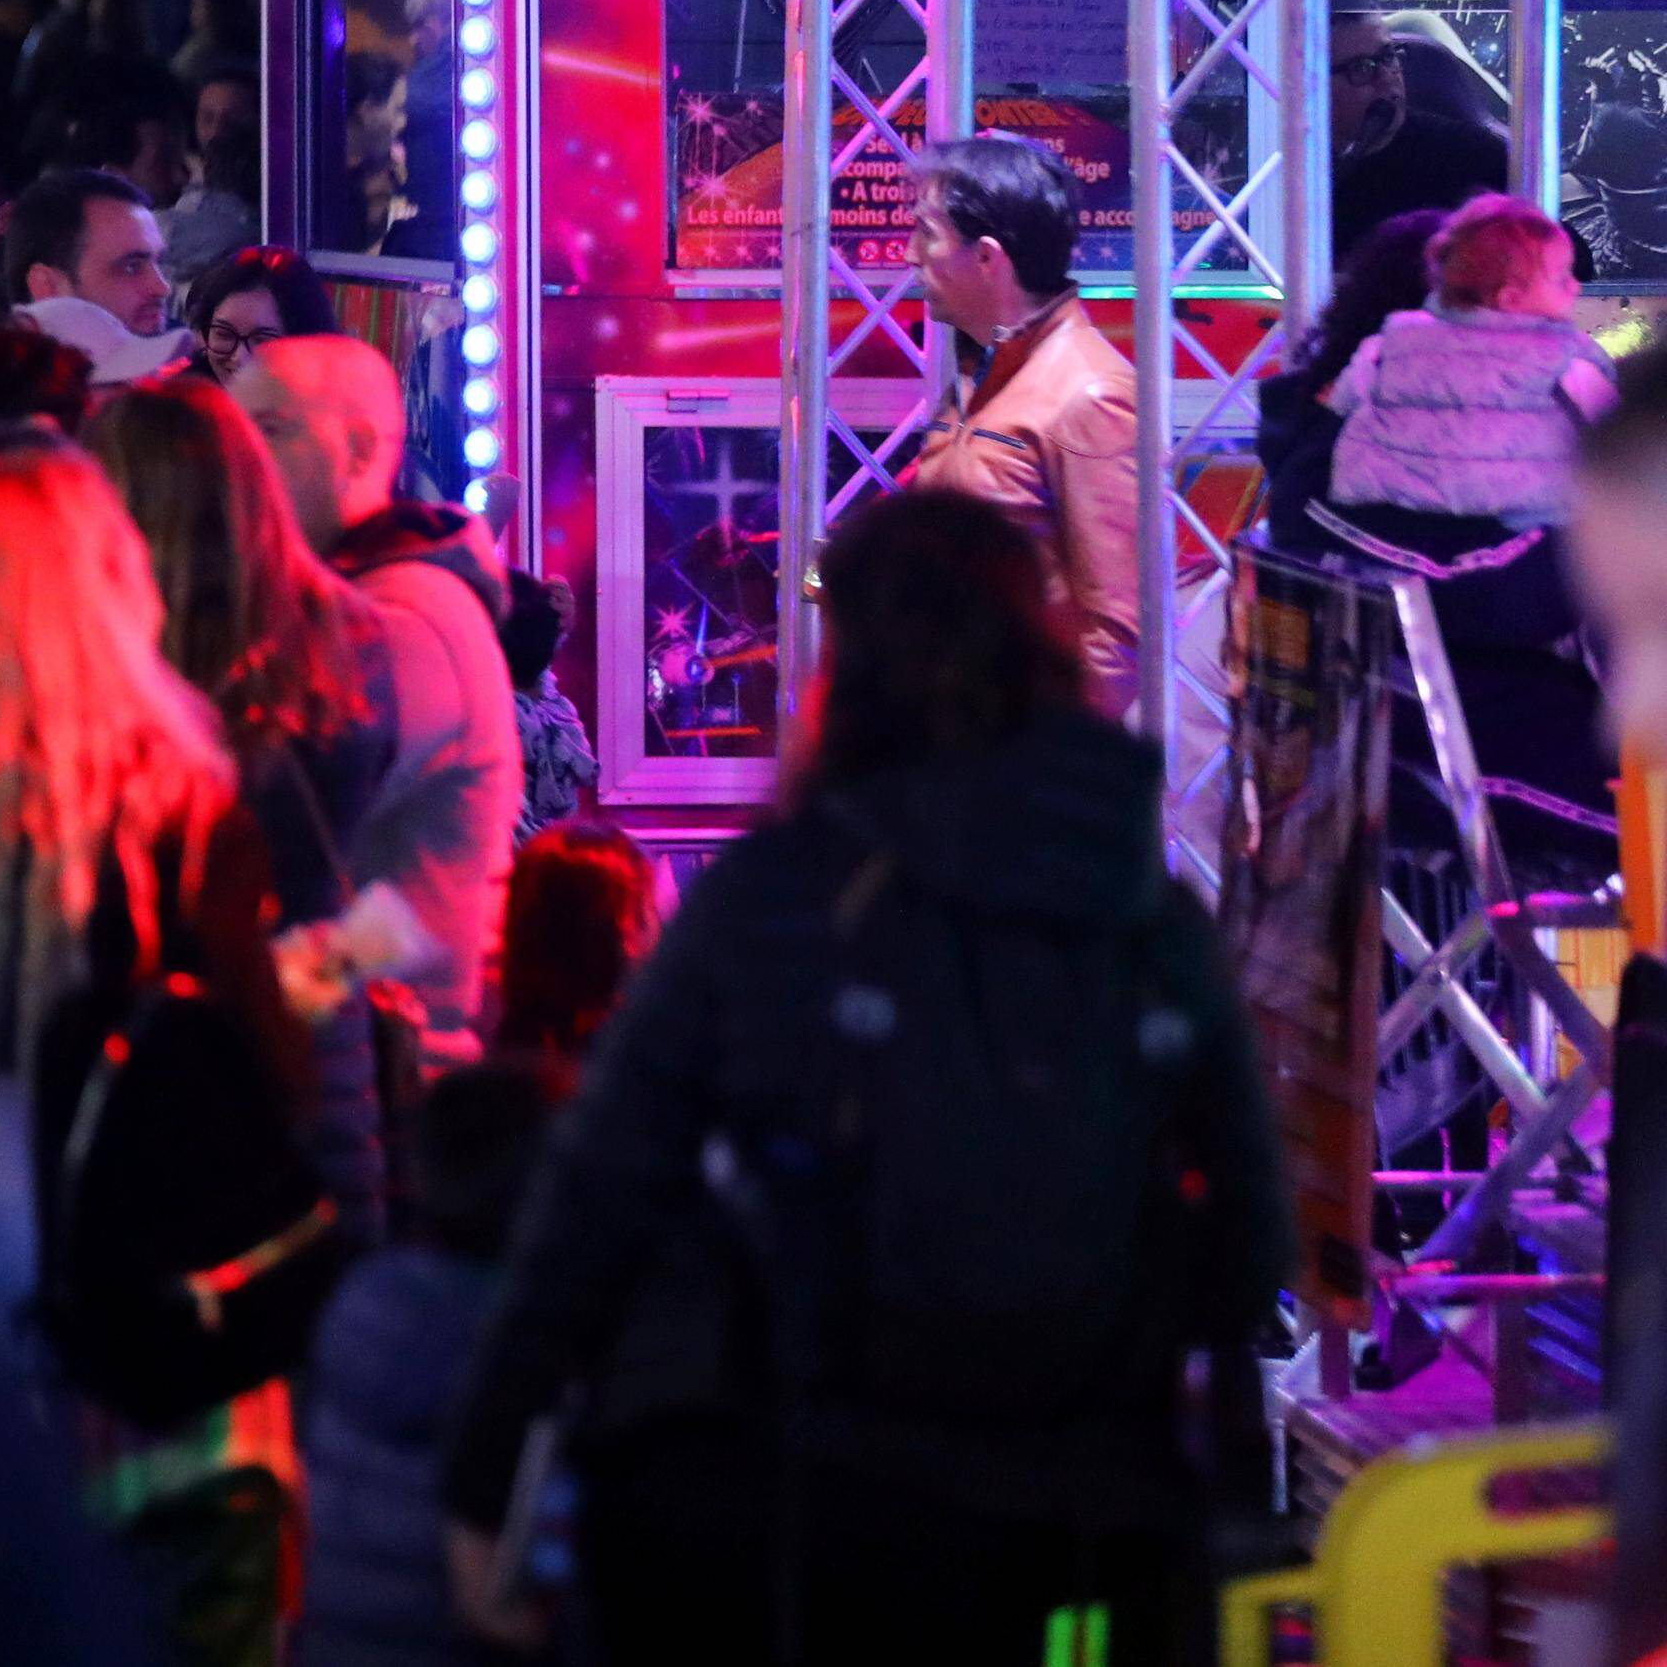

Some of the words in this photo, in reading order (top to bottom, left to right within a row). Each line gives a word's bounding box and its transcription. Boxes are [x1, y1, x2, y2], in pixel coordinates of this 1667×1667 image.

[686, 206, 718, 225] Les
[723, 204, 784, 225] enfant
[831, 205, 888, 225] moins
